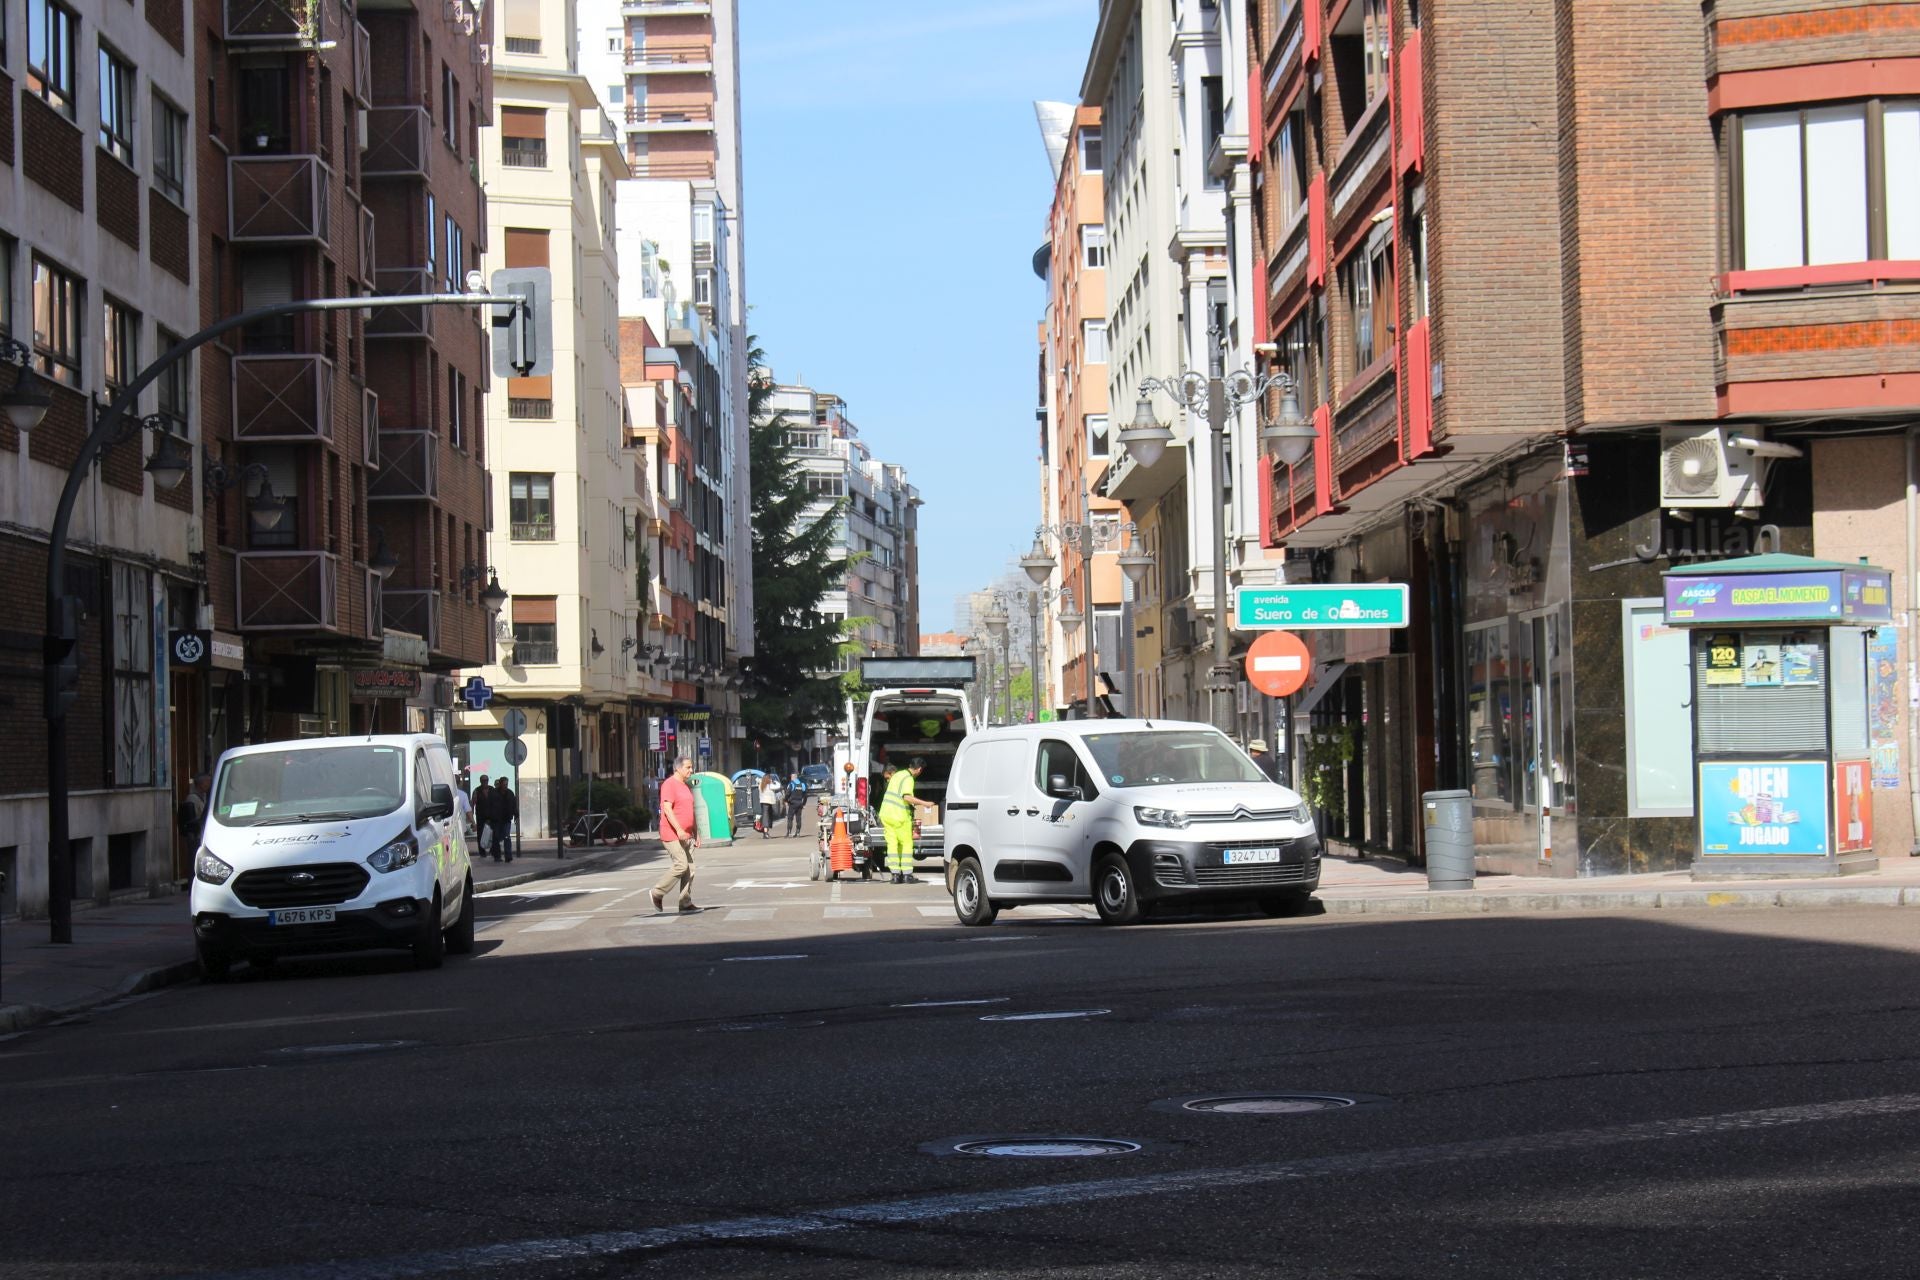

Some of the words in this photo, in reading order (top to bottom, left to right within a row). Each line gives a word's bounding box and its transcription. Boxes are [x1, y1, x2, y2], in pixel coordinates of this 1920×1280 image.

[1636, 517, 1779, 560] Julián
[1253, 595, 1289, 604] avenida
[1682, 589, 1716, 597] RASCAS
[1732, 588, 1764, 605] RASCA
[1766, 588, 1778, 603] EL
[1779, 586, 1829, 602] MOMENTO
[1254, 608, 1292, 620] Suero
[1302, 608, 1318, 619] de
[1328, 607, 1388, 620] Qones
[1711, 647, 1736, 660] 120
[1738, 767, 1789, 798] BIEN
[251, 834, 319, 846] kapsch
[1739, 826, 1790, 845] JUGADO
[1231, 851, 1256, 862] 3247
[1258, 851, 1277, 861] LYJ
[278, 911, 306, 923] 4676
[309, 909, 333, 921] KPS
